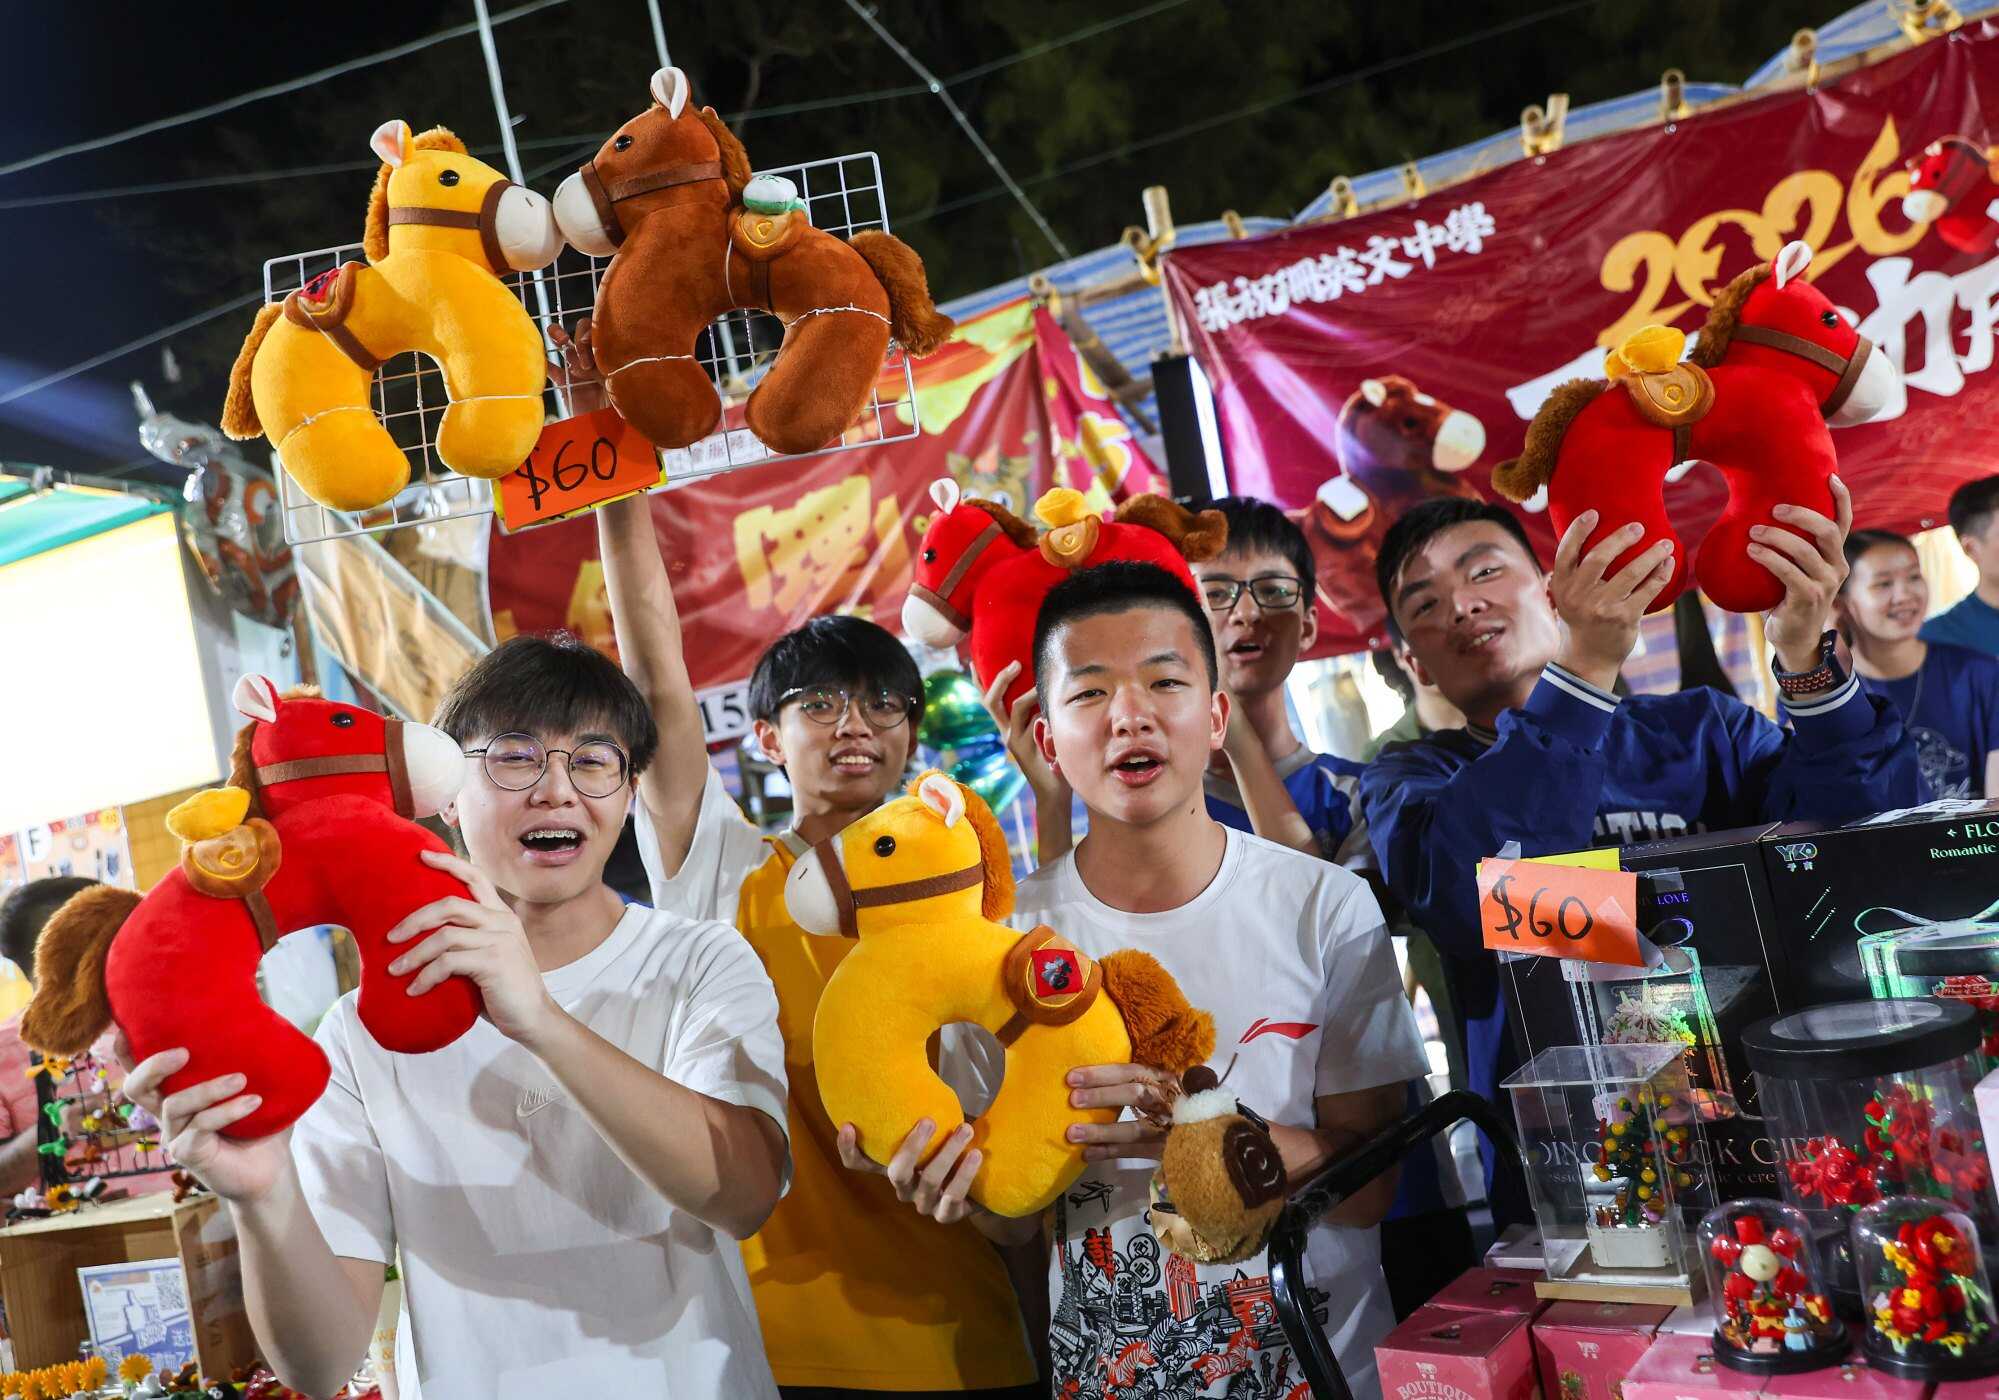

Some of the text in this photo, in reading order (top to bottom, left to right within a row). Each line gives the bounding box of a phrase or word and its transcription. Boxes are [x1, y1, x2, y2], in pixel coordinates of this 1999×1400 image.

[1597, 114, 1932, 350] 2026
[515, 436, 617, 511] $60
[1929, 843, 1997, 859] Romantic
[1491, 875, 1594, 940] $60
[1656, 892, 1689, 905] LOVE
